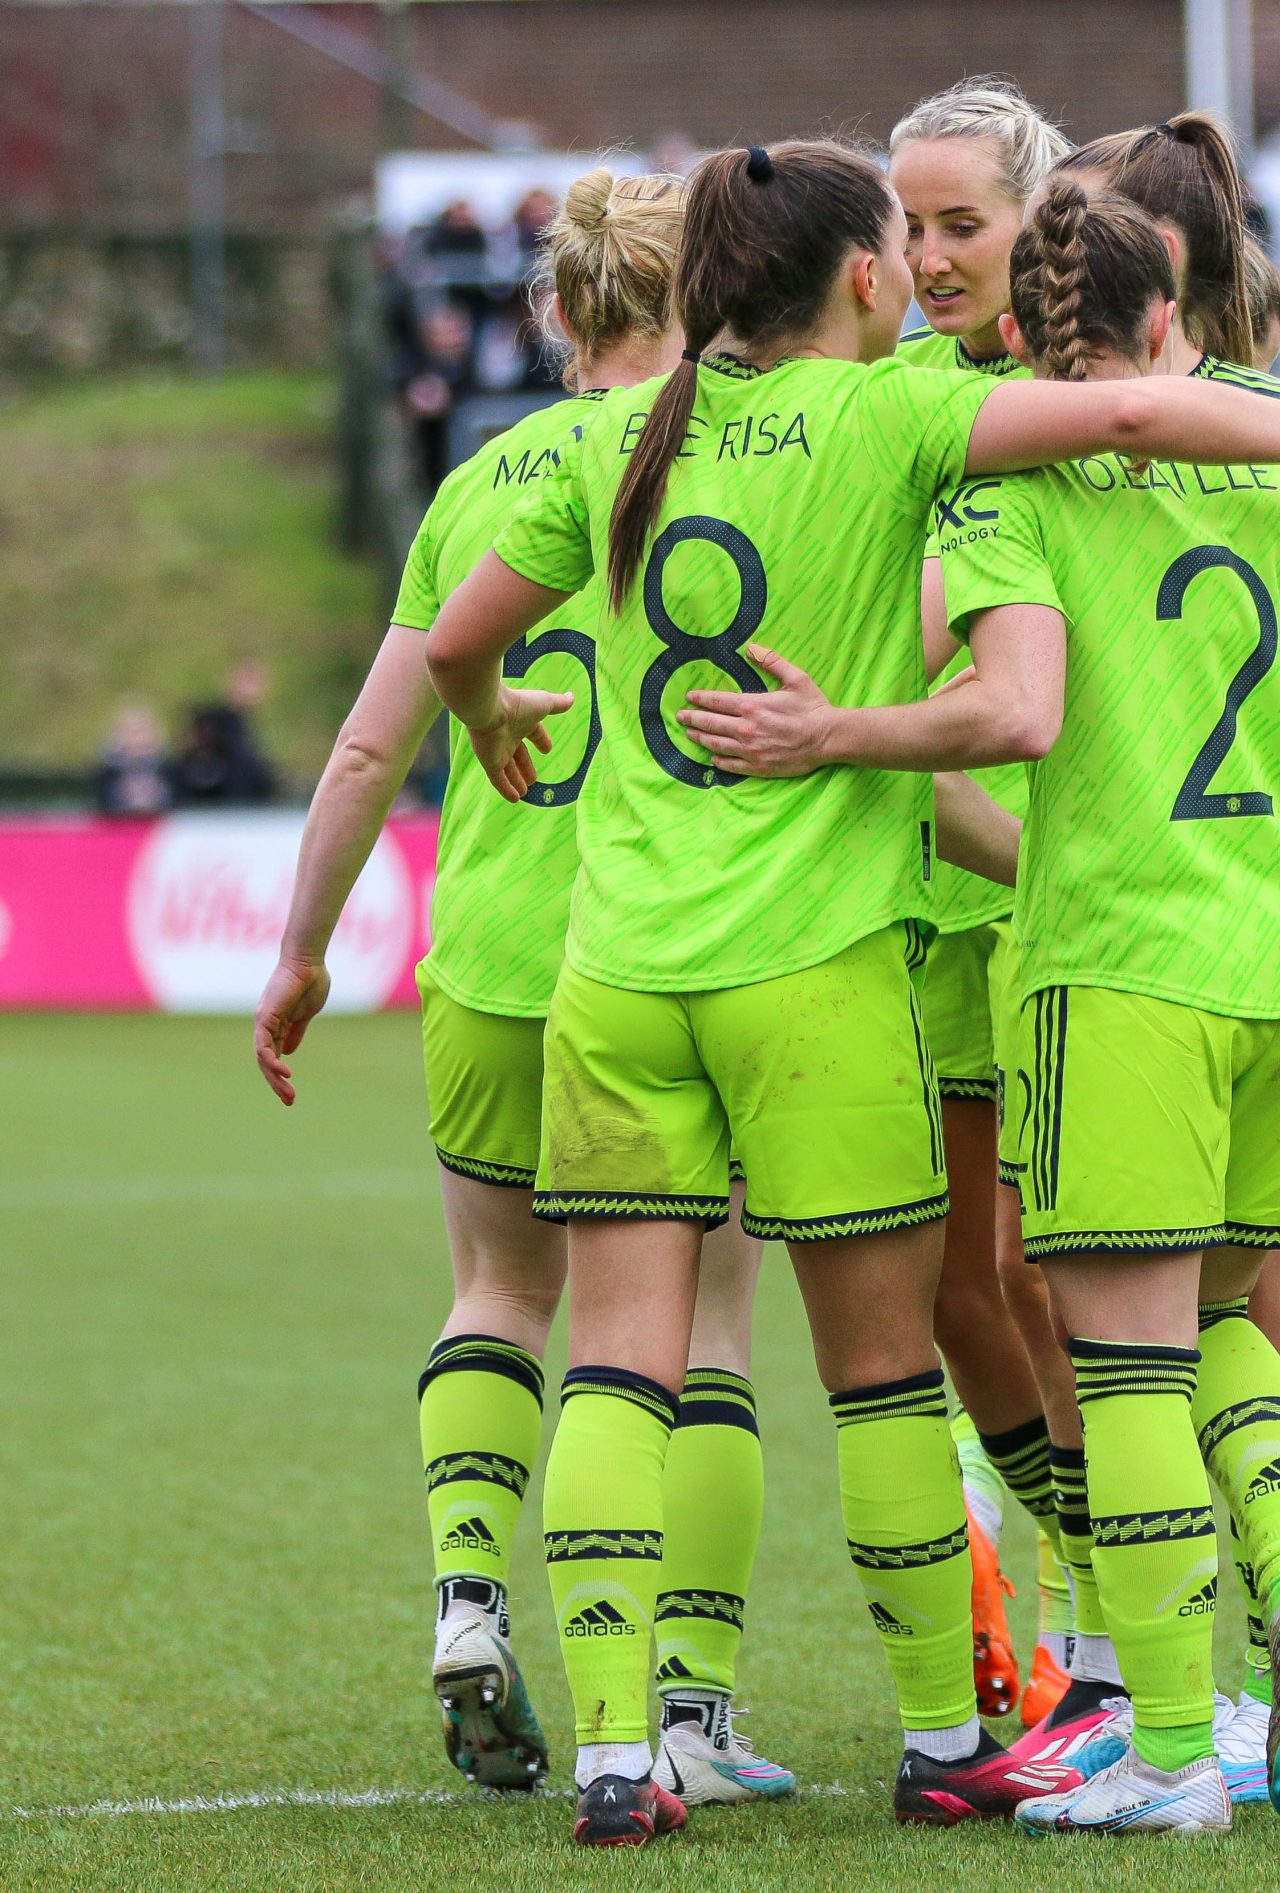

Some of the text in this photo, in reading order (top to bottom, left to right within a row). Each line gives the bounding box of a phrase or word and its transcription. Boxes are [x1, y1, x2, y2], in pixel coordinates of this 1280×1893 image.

[619, 411, 813, 464] BE RISA
[492, 448, 562, 491] MA
[936, 480, 1003, 534] XC
[940, 526, 1000, 555] NOLOGY
[639, 514, 769, 790] 8
[1155, 544, 1280, 822] 2
[440, 1535, 502, 1558] adidas
[564, 1622, 636, 1638] adidas
